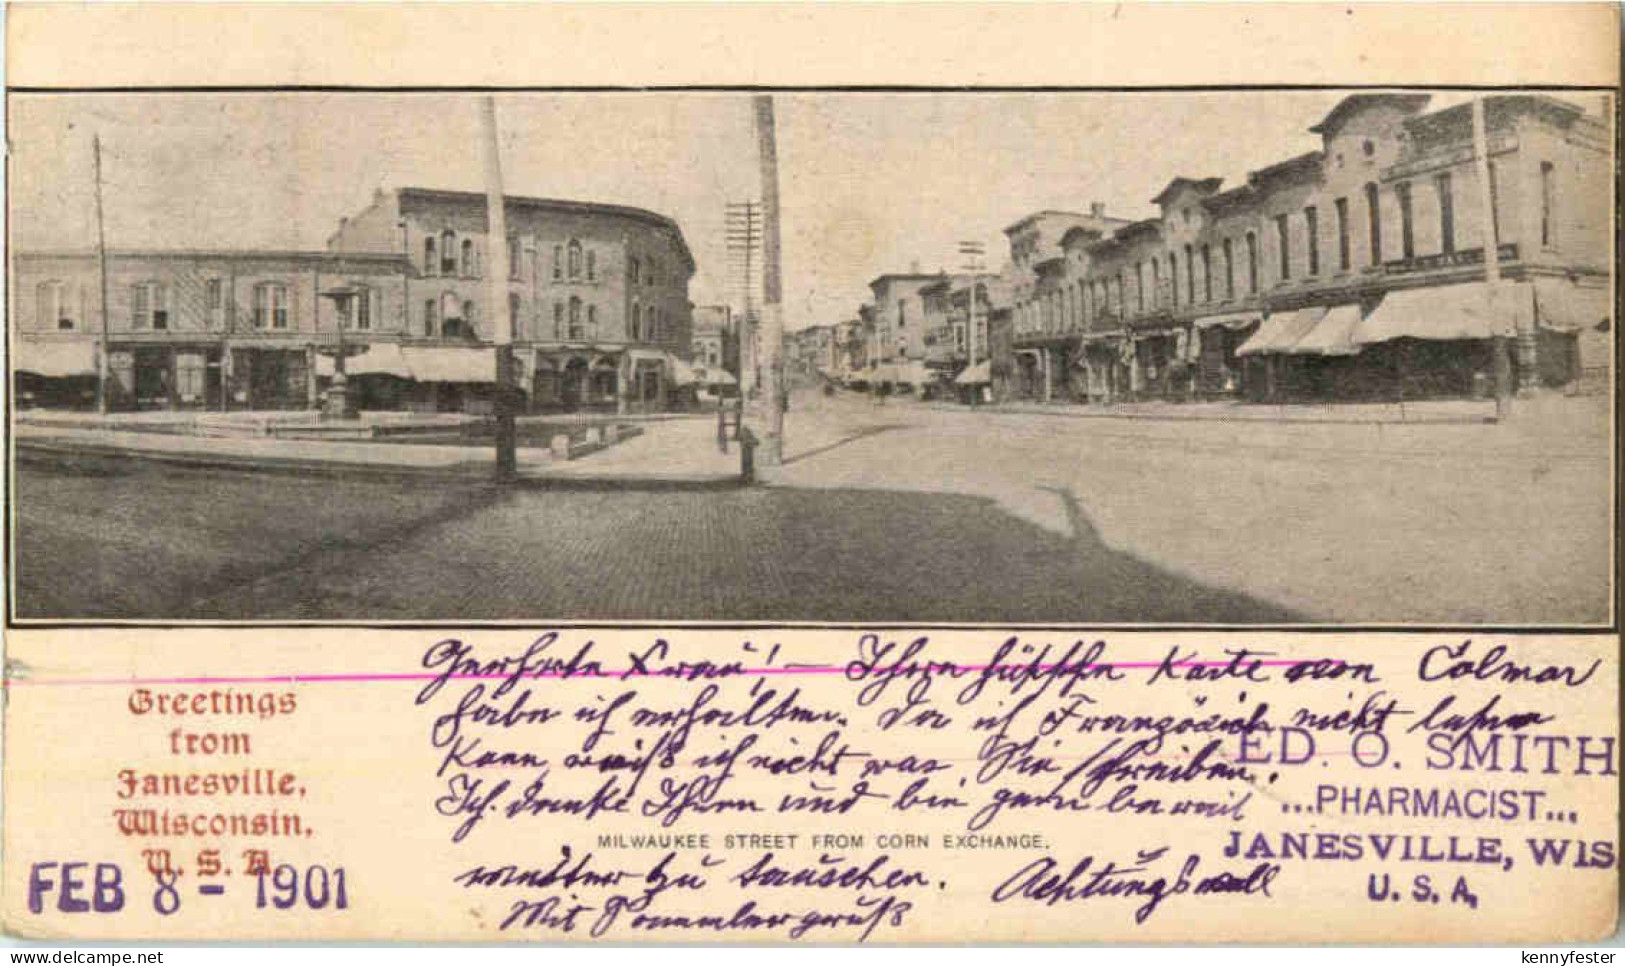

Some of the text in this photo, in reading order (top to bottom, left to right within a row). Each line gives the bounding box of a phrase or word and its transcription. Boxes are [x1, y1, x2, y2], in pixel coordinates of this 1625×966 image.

[1418, 640, 1603, 686] Colmar
[128, 688, 296, 717] Greetings
[1294, 690, 1416, 736] nicht
[170, 728, 251, 755] from
[1235, 725, 1617, 777] ED. O. SMITH
[598, 833, 711, 850] MILWAUKEE
[724, 833, 799, 850] STREET
[811, 834, 864, 850] FROM
[876, 834, 929, 850] CORN
[1223, 831, 1515, 871] JANESVILLE,
[197, 849, 232, 877] S.
[28, 861, 126, 914] FEB
[153, 867, 181, 916] 8
[256, 865, 349, 910] 1901
[1367, 873, 1401, 902] U.
[1412, 875, 1440, 903] S.
